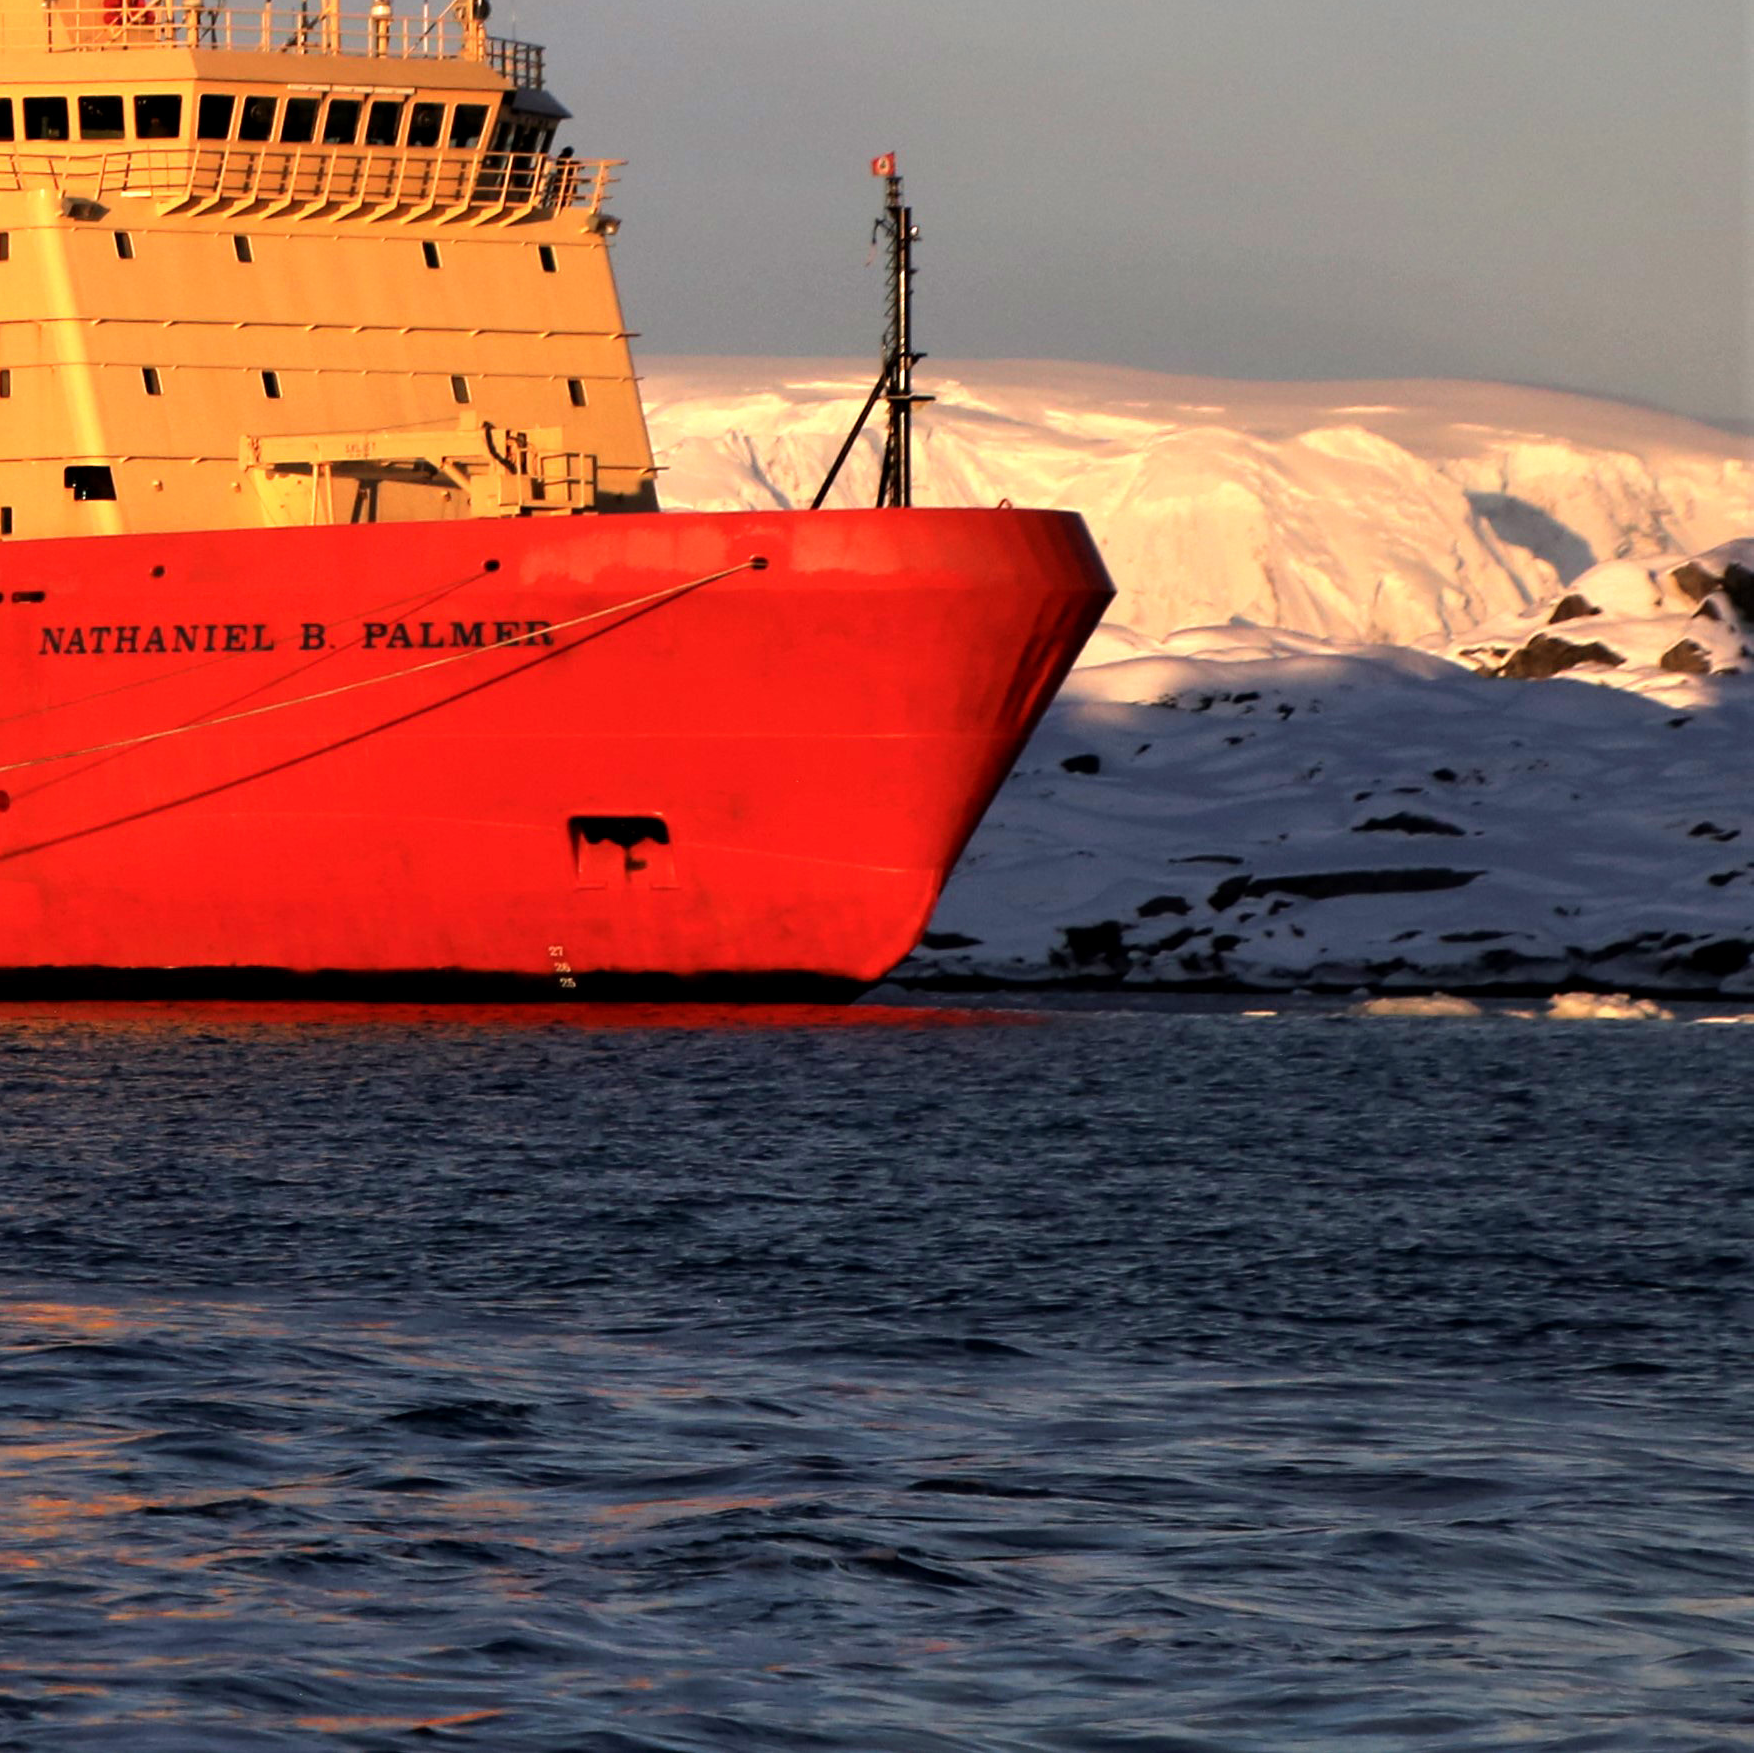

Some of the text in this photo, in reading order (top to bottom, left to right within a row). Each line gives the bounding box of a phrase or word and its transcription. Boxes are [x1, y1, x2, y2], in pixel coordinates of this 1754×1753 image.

[39, 620, 555, 656] NATHANIEL B. PALMER
[548, 945, 564, 957] 27
